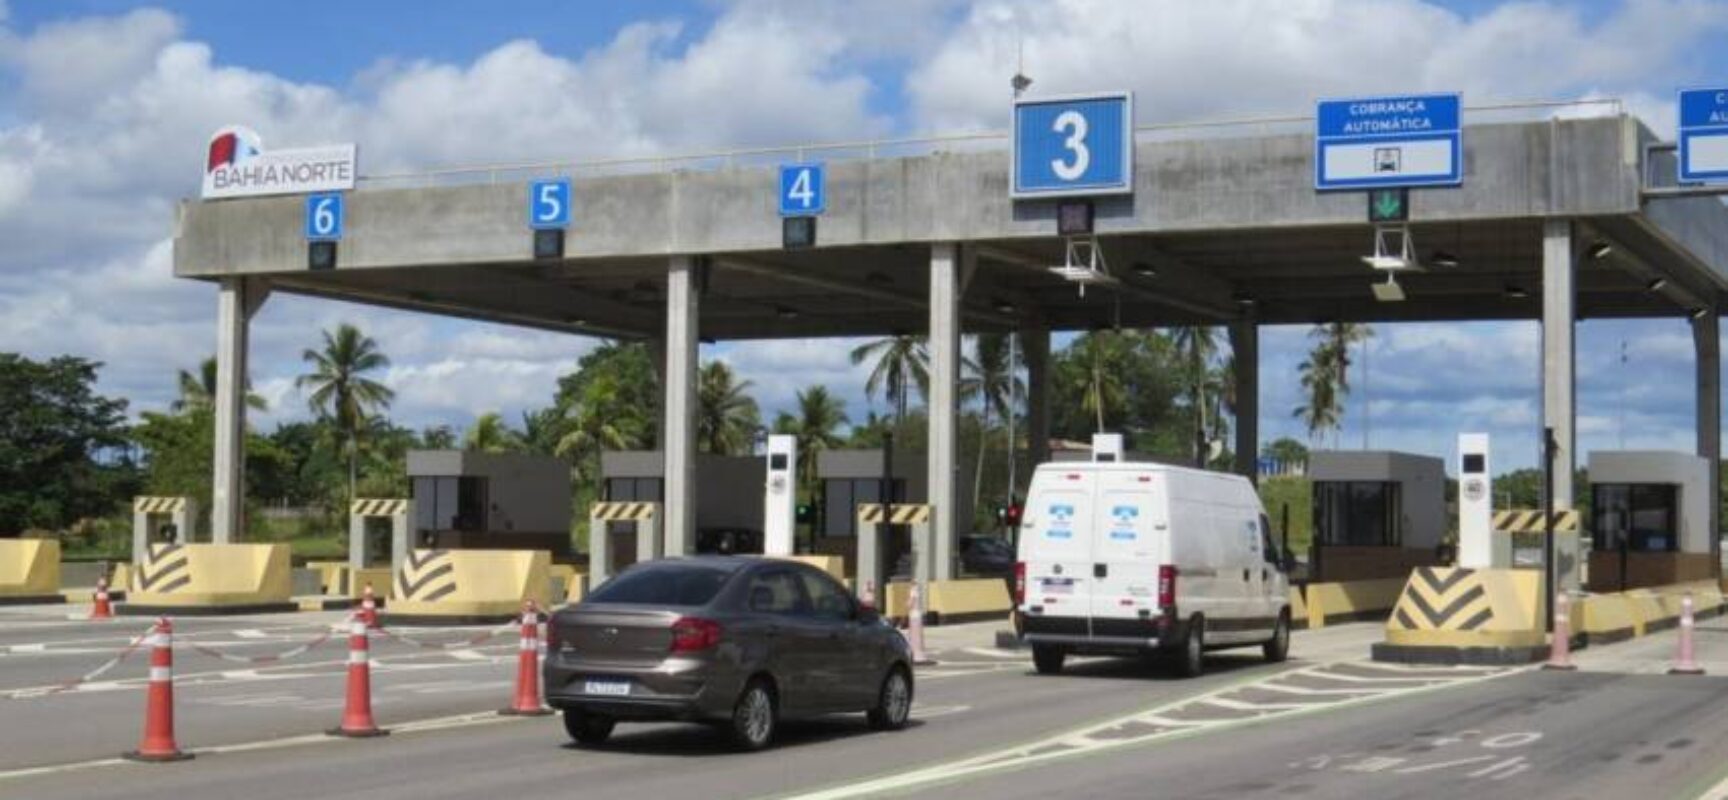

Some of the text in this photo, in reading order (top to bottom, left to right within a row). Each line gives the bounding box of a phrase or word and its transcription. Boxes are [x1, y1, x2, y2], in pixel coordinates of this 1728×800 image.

[1343, 117, 1432, 133] AUTOMÁTICA
[1349, 100, 1426, 115] COBRANÇA
[1051, 110, 1090, 180] 3
[213, 160, 351, 189] BAHIA NORTE
[788, 168, 815, 208] 4
[315, 199, 334, 234] 6
[539, 185, 560, 220] 5
